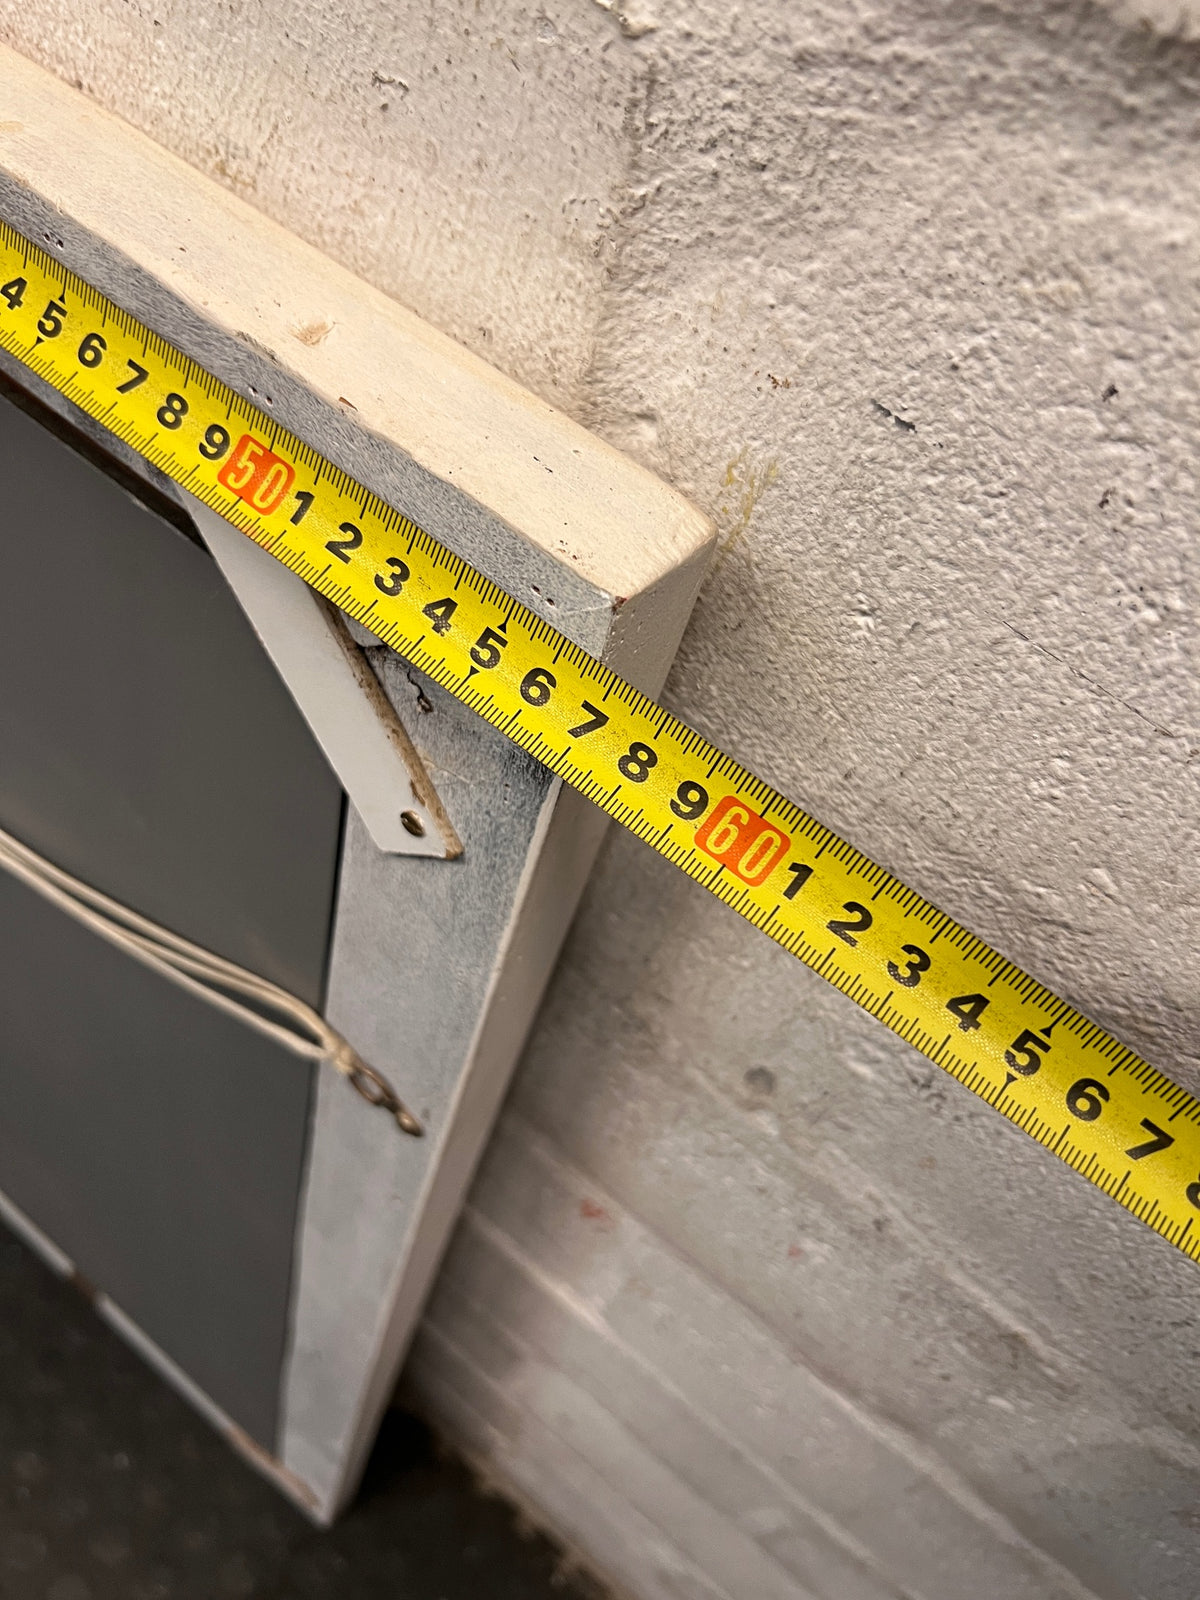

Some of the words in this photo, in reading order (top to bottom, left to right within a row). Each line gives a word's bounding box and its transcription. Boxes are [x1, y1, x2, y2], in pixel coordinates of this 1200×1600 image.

[0, 276, 28, 310] 4
[37, 300, 68, 338] 5
[77, 332, 108, 369] 6
[116, 359, 150, 394] 7
[156, 392, 189, 430] 8
[198, 423, 231, 461] 9
[227, 441, 289, 507] 50
[289, 490, 315, 526] 1
[324, 521, 364, 564] 2
[373, 556, 411, 597] 3
[421, 597, 459, 635] 4
[469, 627, 508, 669] 5
[519, 667, 557, 707] 6
[567, 700, 610, 739] 7
[617, 741, 658, 783] 8
[669, 780, 709, 821] 9
[705, 805, 782, 879] 60
[782, 862, 814, 900] 1
[825, 900, 873, 947] 2
[887, 944, 932, 988] 3
[945, 993, 991, 1033] 4
[1004, 1028, 1052, 1076] 5
[1065, 1077, 1110, 1122] 6
[1124, 1117, 1175, 1161] 7
